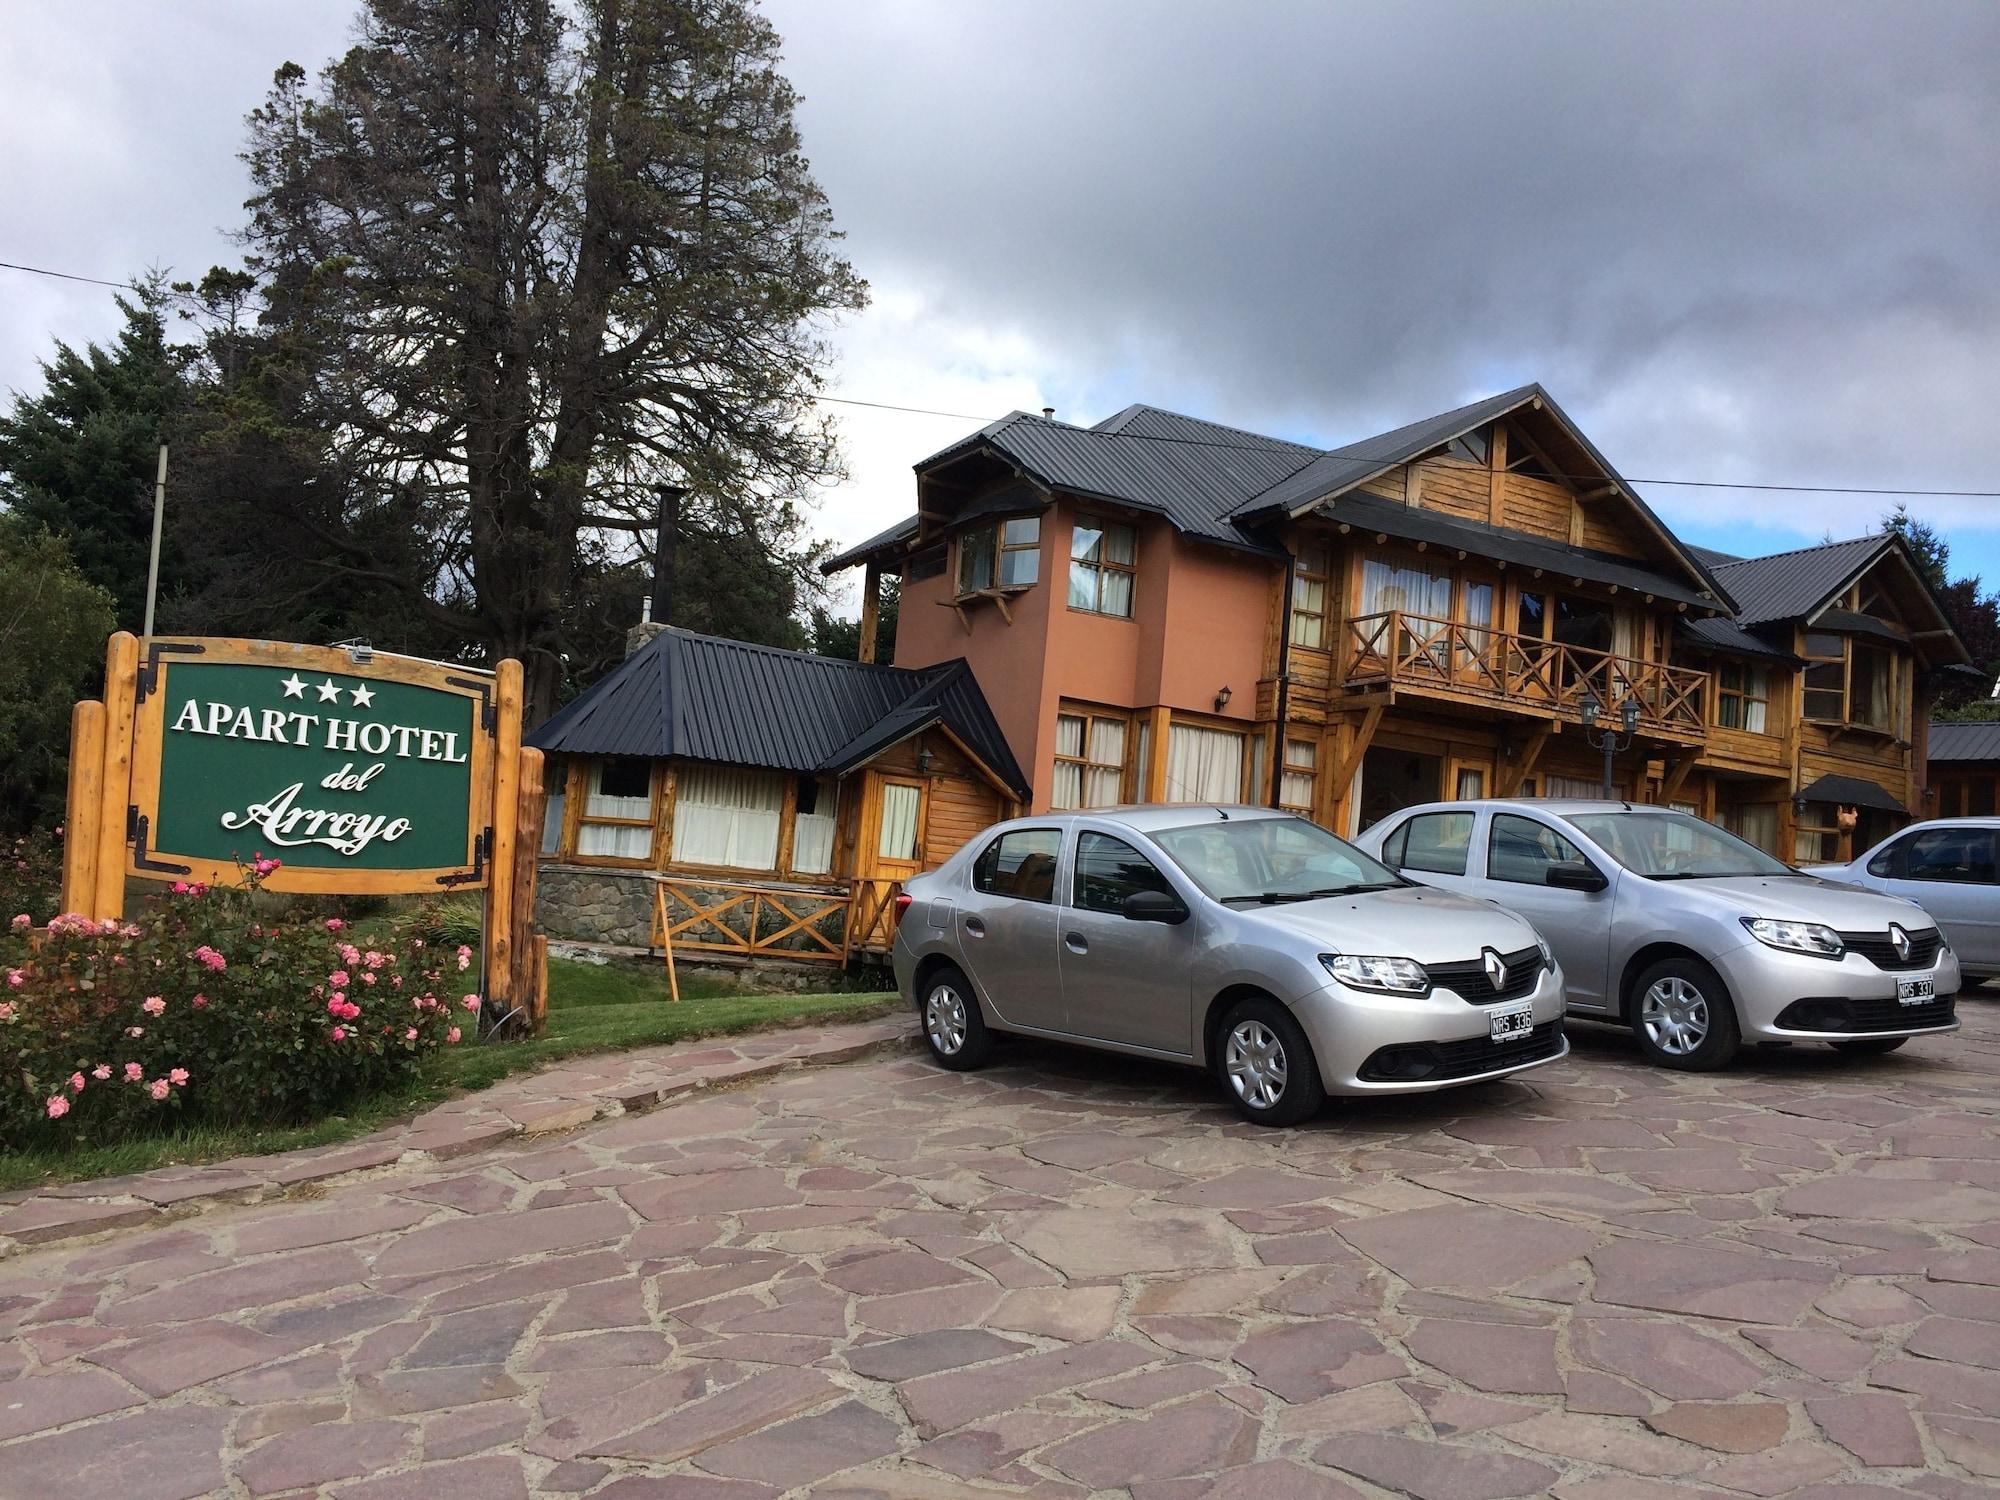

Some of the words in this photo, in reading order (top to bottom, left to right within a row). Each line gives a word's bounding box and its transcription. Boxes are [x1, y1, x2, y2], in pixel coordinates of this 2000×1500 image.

[171, 699, 319, 746] APART
[324, 717, 468, 764] HOTEL
[320, 762, 385, 792] del
[220, 782, 412, 856] Arroyo
[1899, 983, 1915, 998] NRS
[1918, 980, 1933, 996] 337
[1492, 1016, 1510, 1035] NRS
[1514, 1012, 1532, 1030] 336
